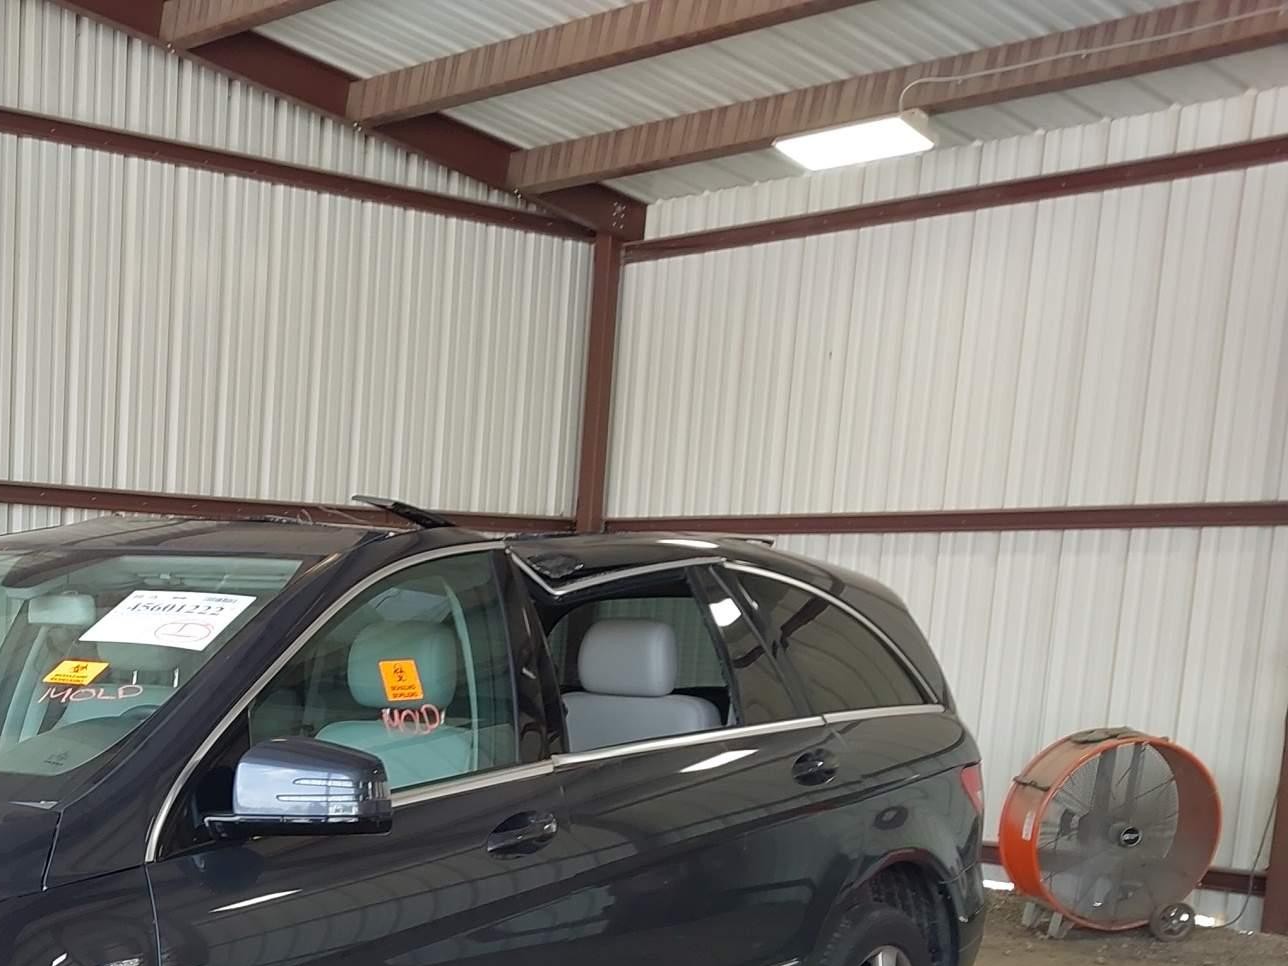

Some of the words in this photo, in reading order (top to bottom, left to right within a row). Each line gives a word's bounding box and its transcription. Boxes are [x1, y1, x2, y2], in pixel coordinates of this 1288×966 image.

[127, 601, 225, 616] 45601222
[38, 684, 144, 703] MOLD
[381, 703, 441, 736] MOLD
